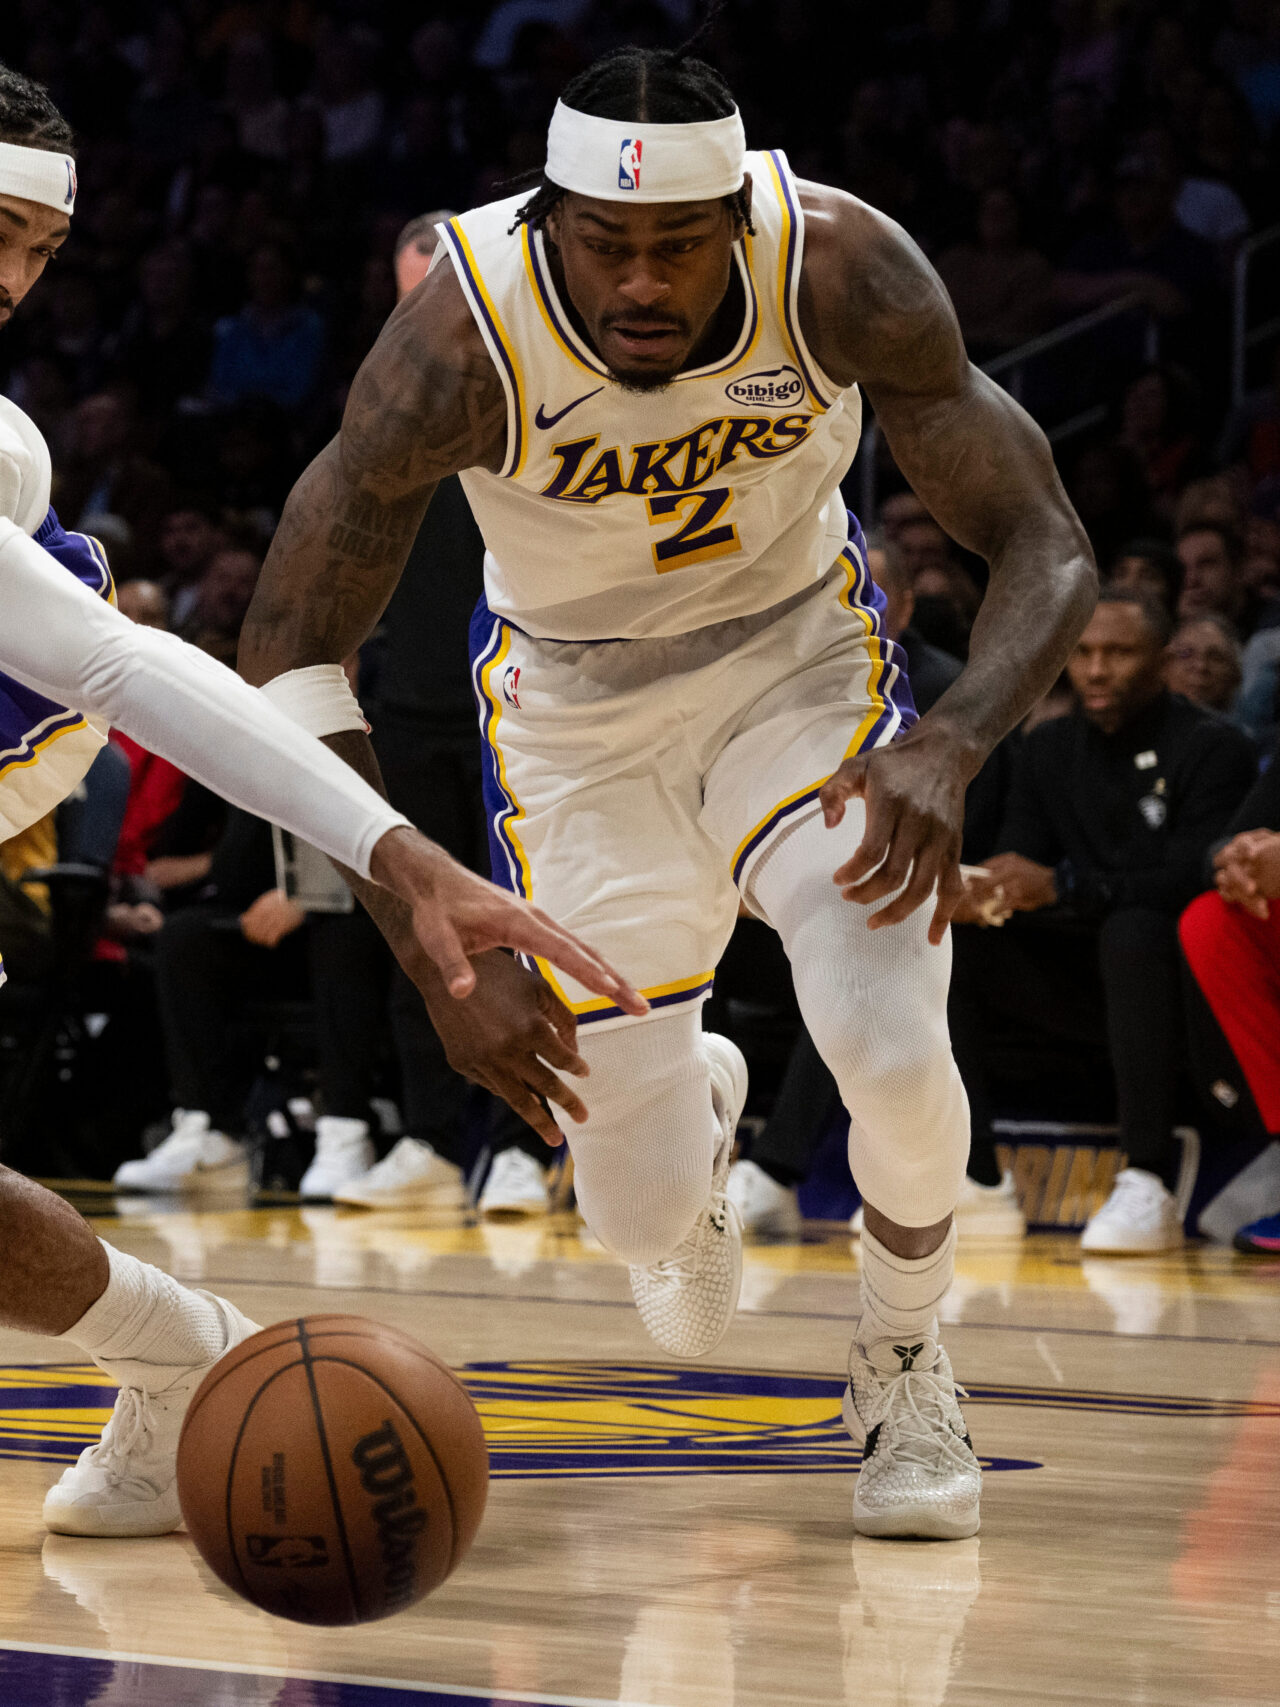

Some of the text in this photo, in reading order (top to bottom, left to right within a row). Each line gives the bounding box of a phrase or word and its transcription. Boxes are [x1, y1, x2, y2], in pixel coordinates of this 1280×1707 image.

[733, 380, 801, 400] bibigo
[538, 413, 817, 505] LAKERS
[644, 486, 743, 576] 2
[353, 1419, 428, 1606] Wilson
